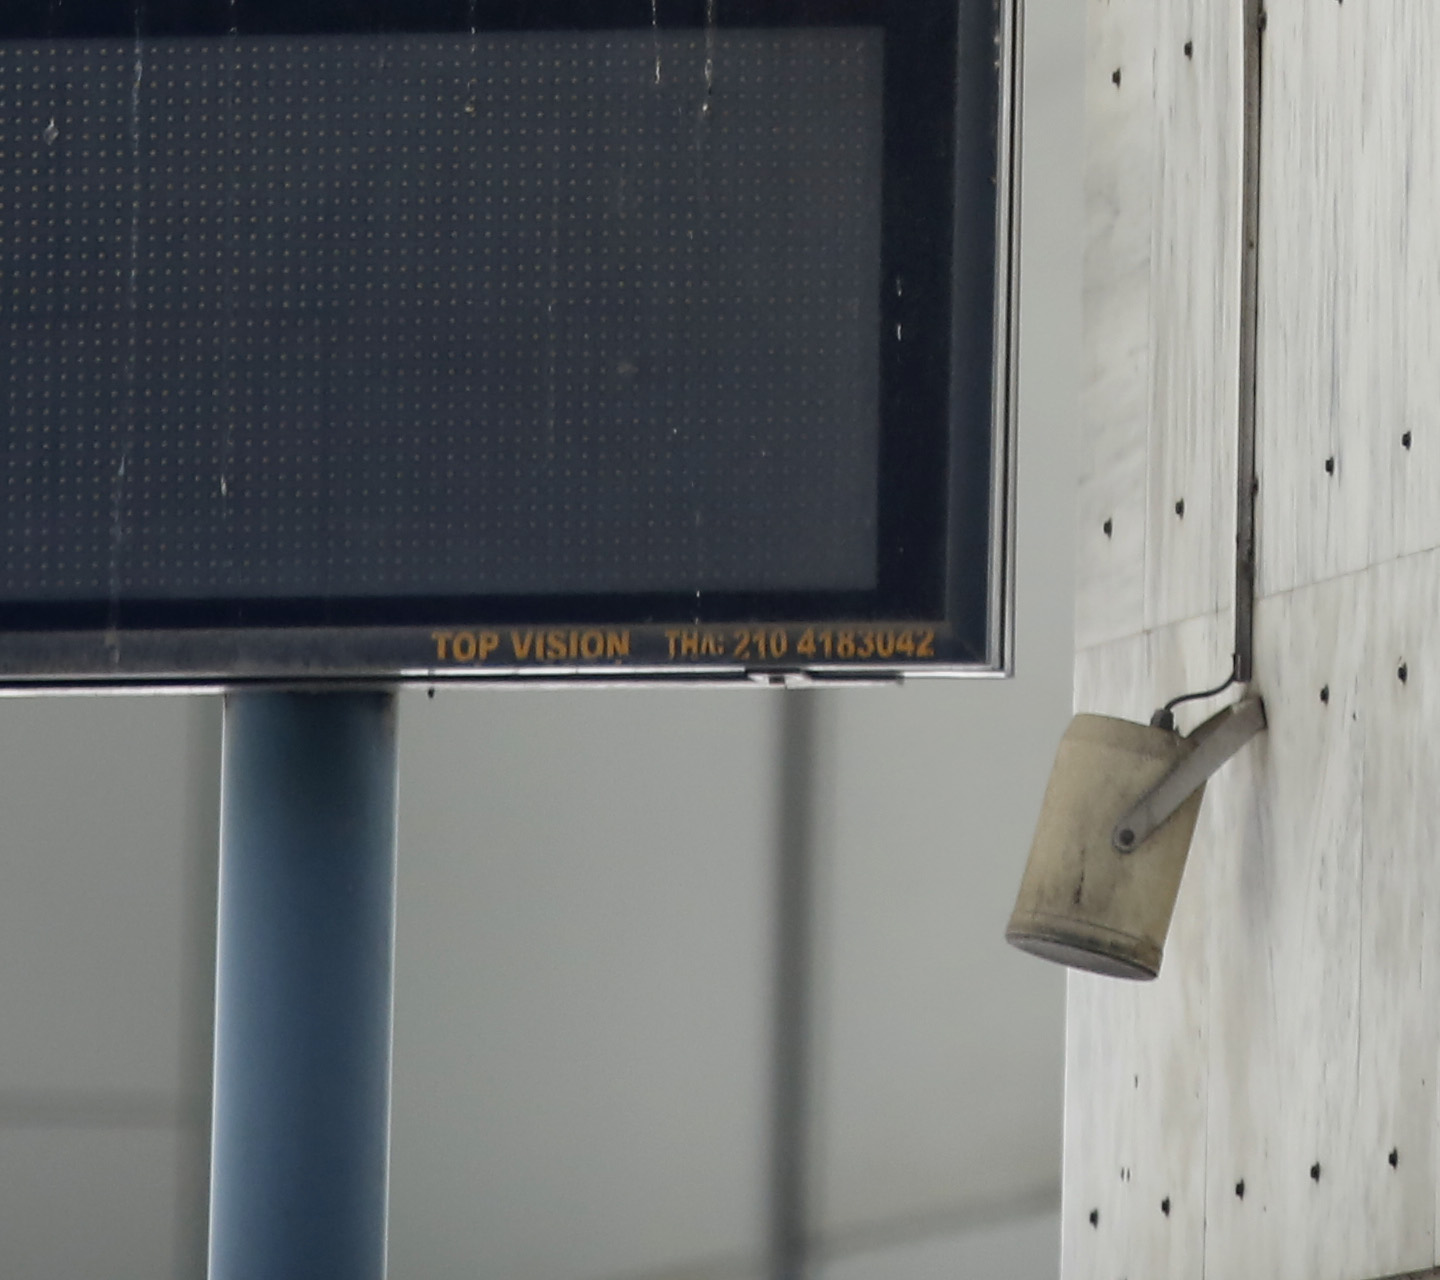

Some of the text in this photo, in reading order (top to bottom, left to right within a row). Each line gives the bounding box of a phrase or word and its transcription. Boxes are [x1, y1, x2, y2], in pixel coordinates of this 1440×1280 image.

[431, 628, 631, 662] TOP VISION
[733, 628, 789, 659] 210
[796, 627, 935, 659] 4183042
